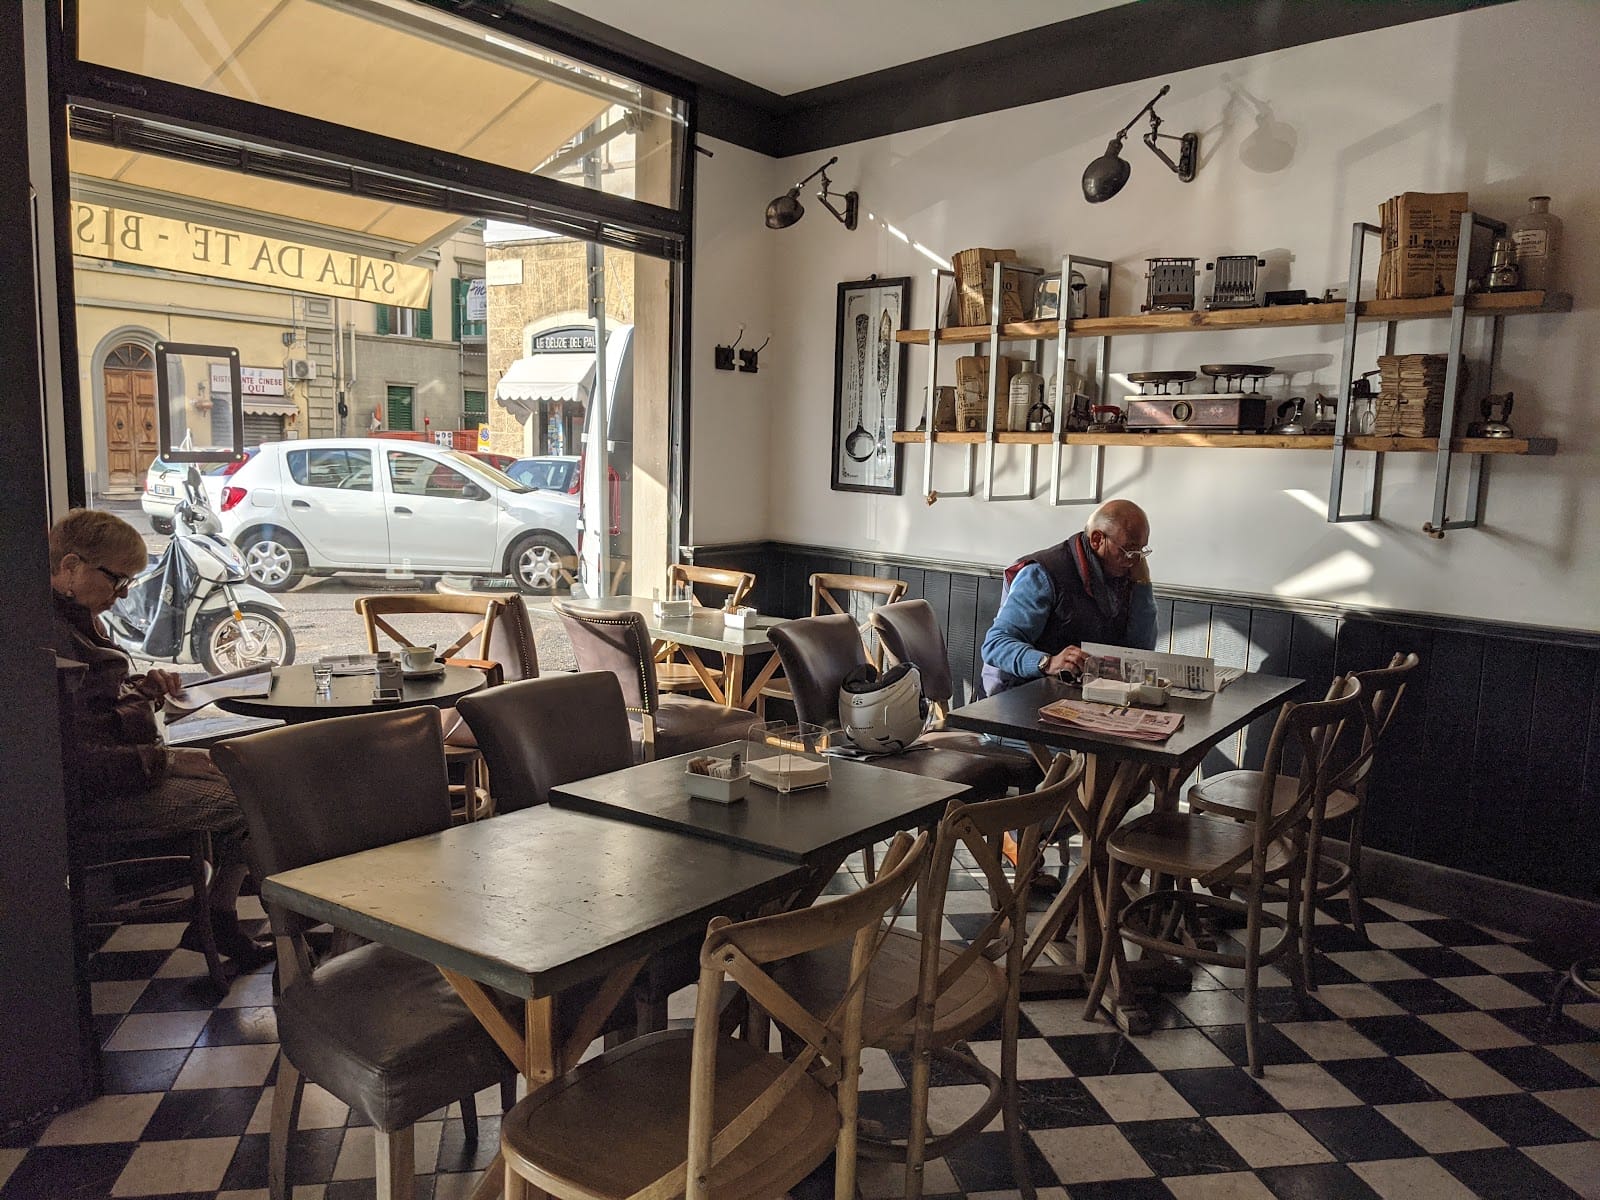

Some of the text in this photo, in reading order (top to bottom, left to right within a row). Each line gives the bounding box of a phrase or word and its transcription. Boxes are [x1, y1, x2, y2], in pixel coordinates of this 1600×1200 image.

[536, 337, 545, 349] LE
[569, 336, 582, 348] DEL
[583, 335, 597, 348] PAL
[258, 377, 283, 386] CINESE
[248, 384, 266, 393] QUI
